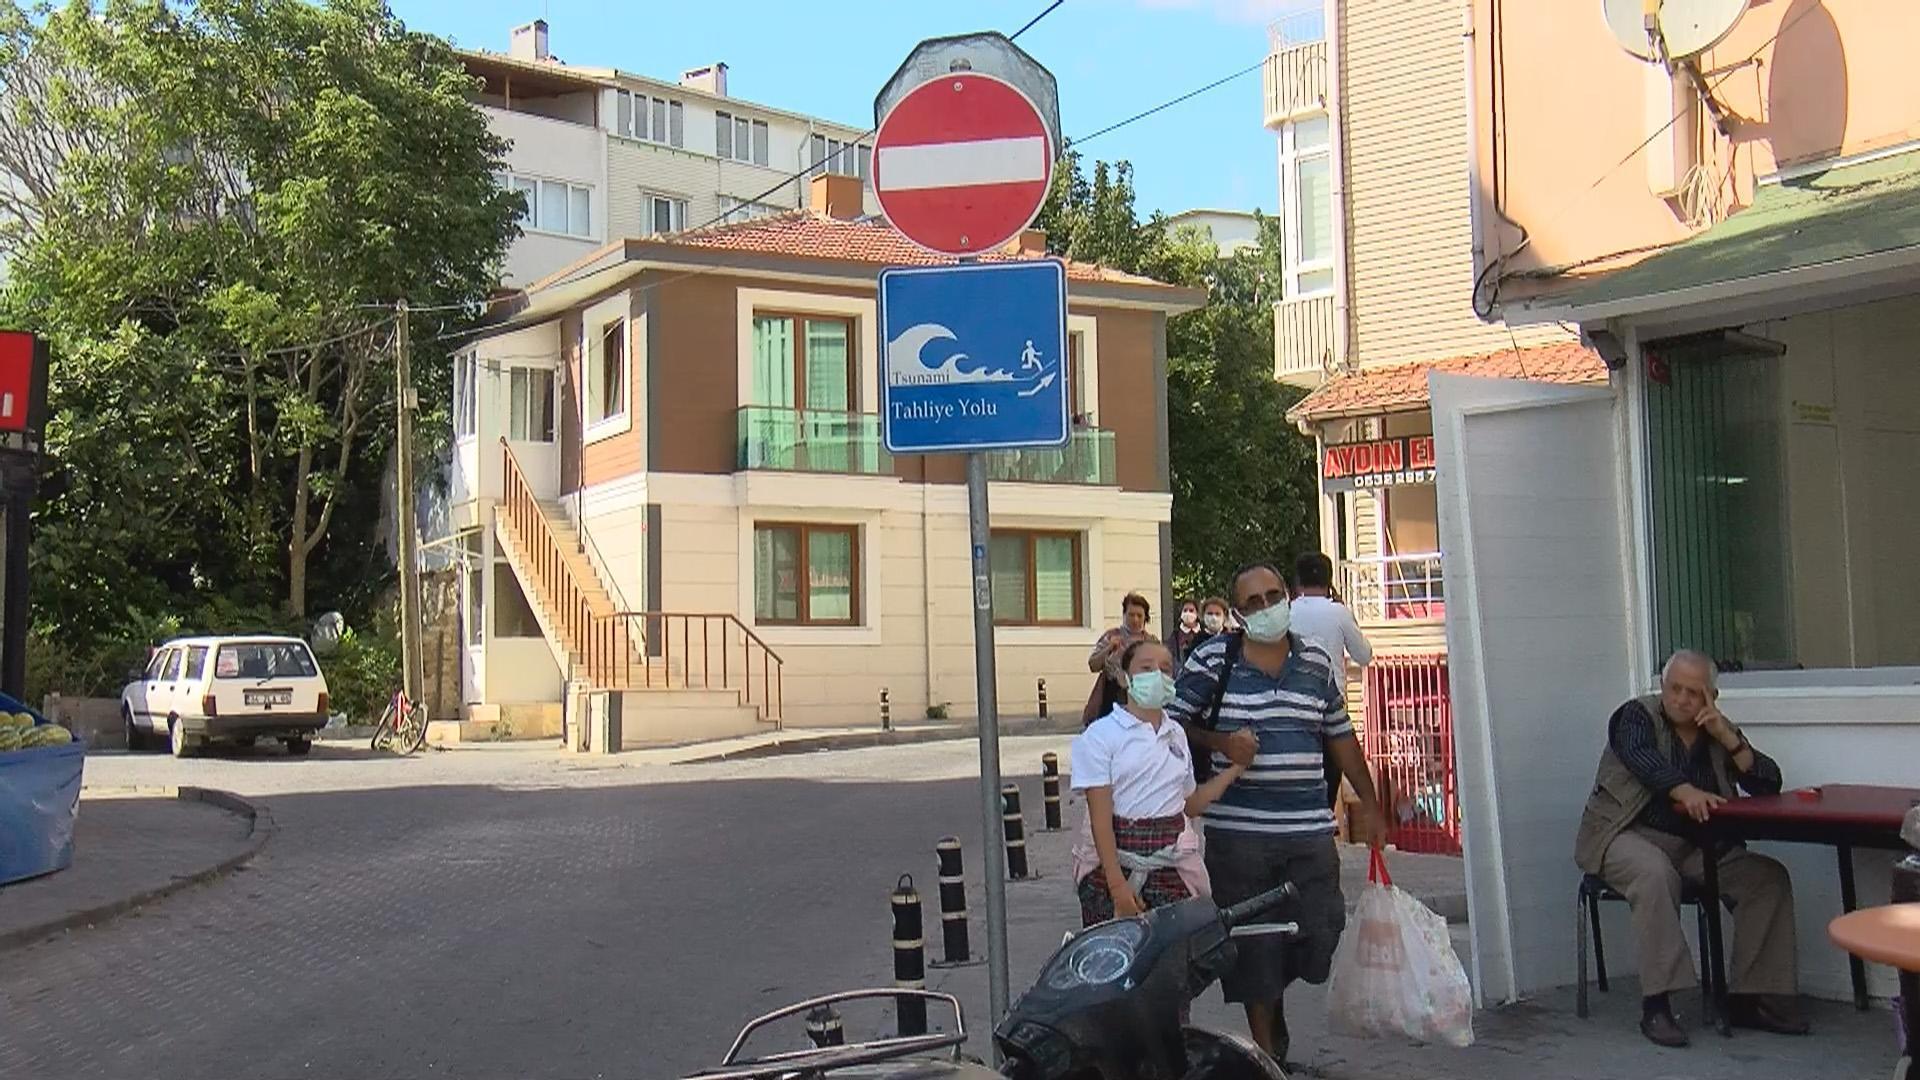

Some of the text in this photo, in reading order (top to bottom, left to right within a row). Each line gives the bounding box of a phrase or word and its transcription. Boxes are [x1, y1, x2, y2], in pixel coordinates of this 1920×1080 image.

[893, 369, 950, 385] Tsunami
[891, 398, 998, 424] Tahliye Yolu
[1324, 440, 1403, 478] AYDIN
